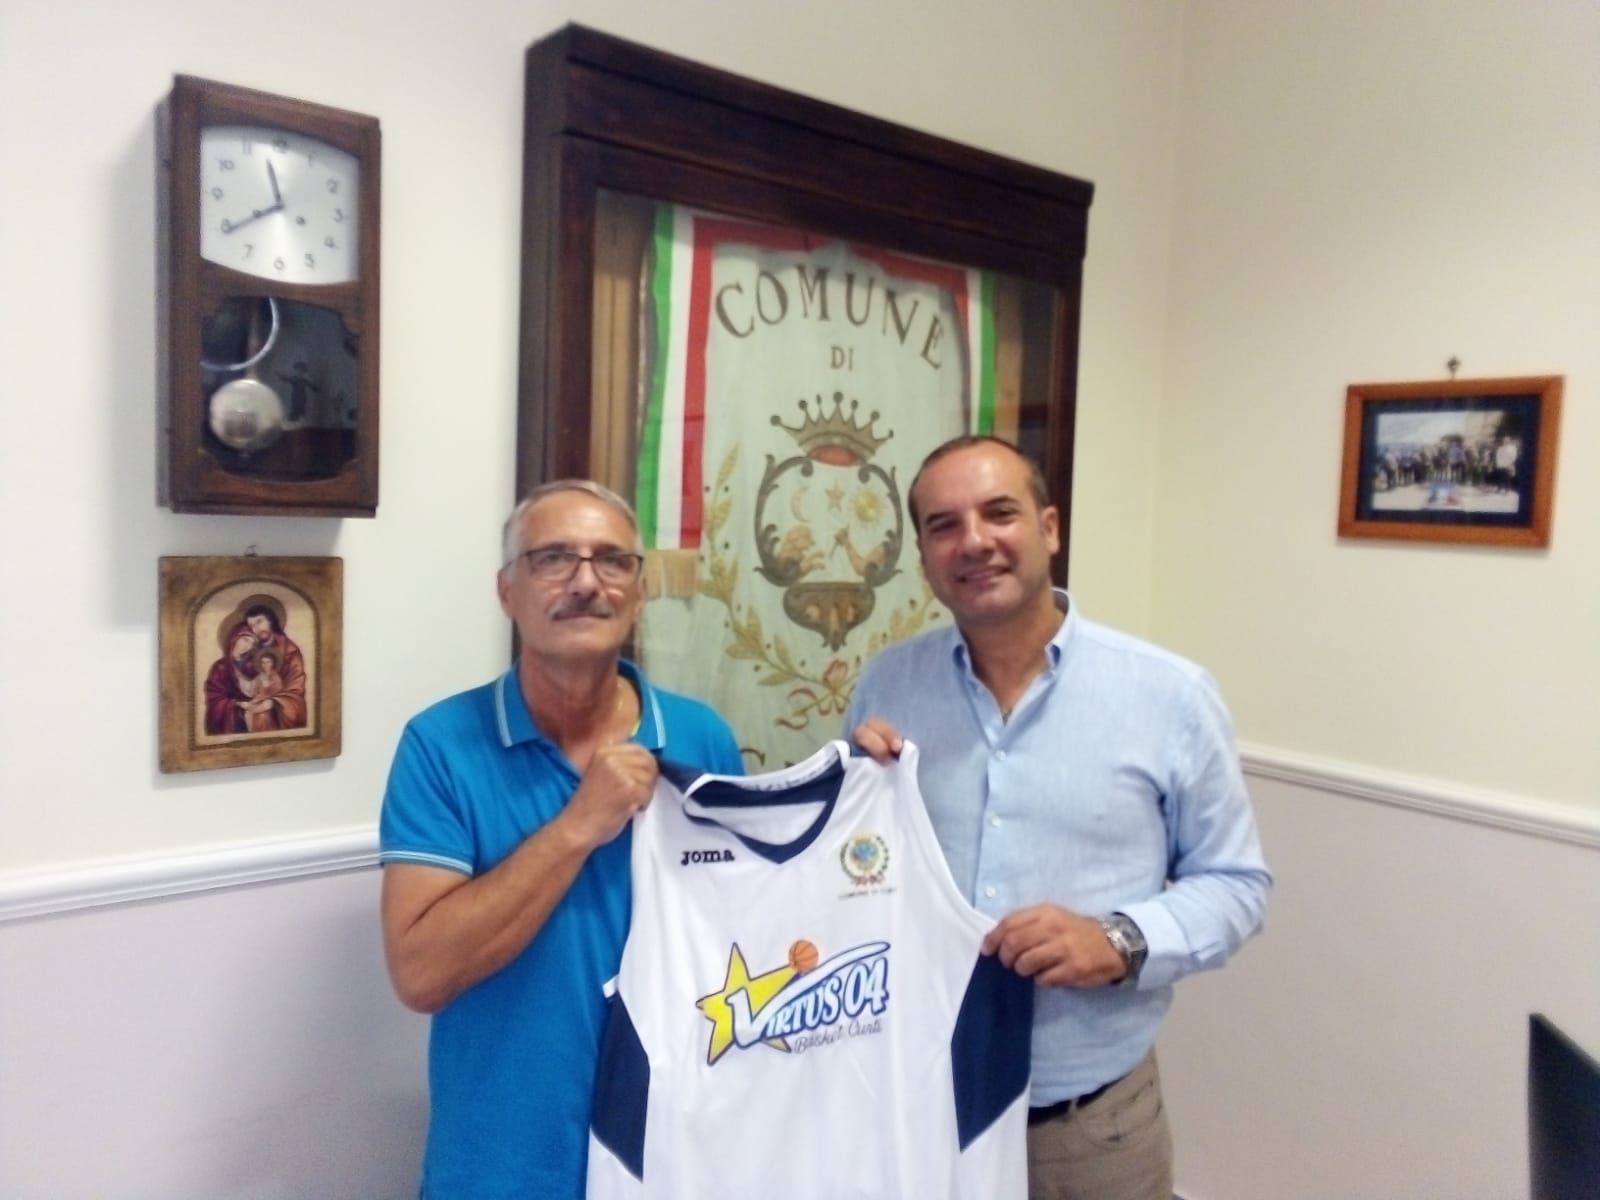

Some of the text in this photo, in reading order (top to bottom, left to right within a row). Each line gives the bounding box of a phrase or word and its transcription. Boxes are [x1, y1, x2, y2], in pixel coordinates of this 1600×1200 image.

[211, 186, 224, 201] 9
[326, 177, 339, 194] 2
[333, 207, 344, 223] 3
[219, 217, 232, 234] 8
[323, 235, 337, 249] 4
[243, 243, 255, 259] 7
[272, 256, 286, 271] 6
[304, 253, 316, 269] 5
[715, 262, 945, 370] COMUNE
[829, 345, 854, 372] DI
[793, 1025, 842, 1054] Basket
